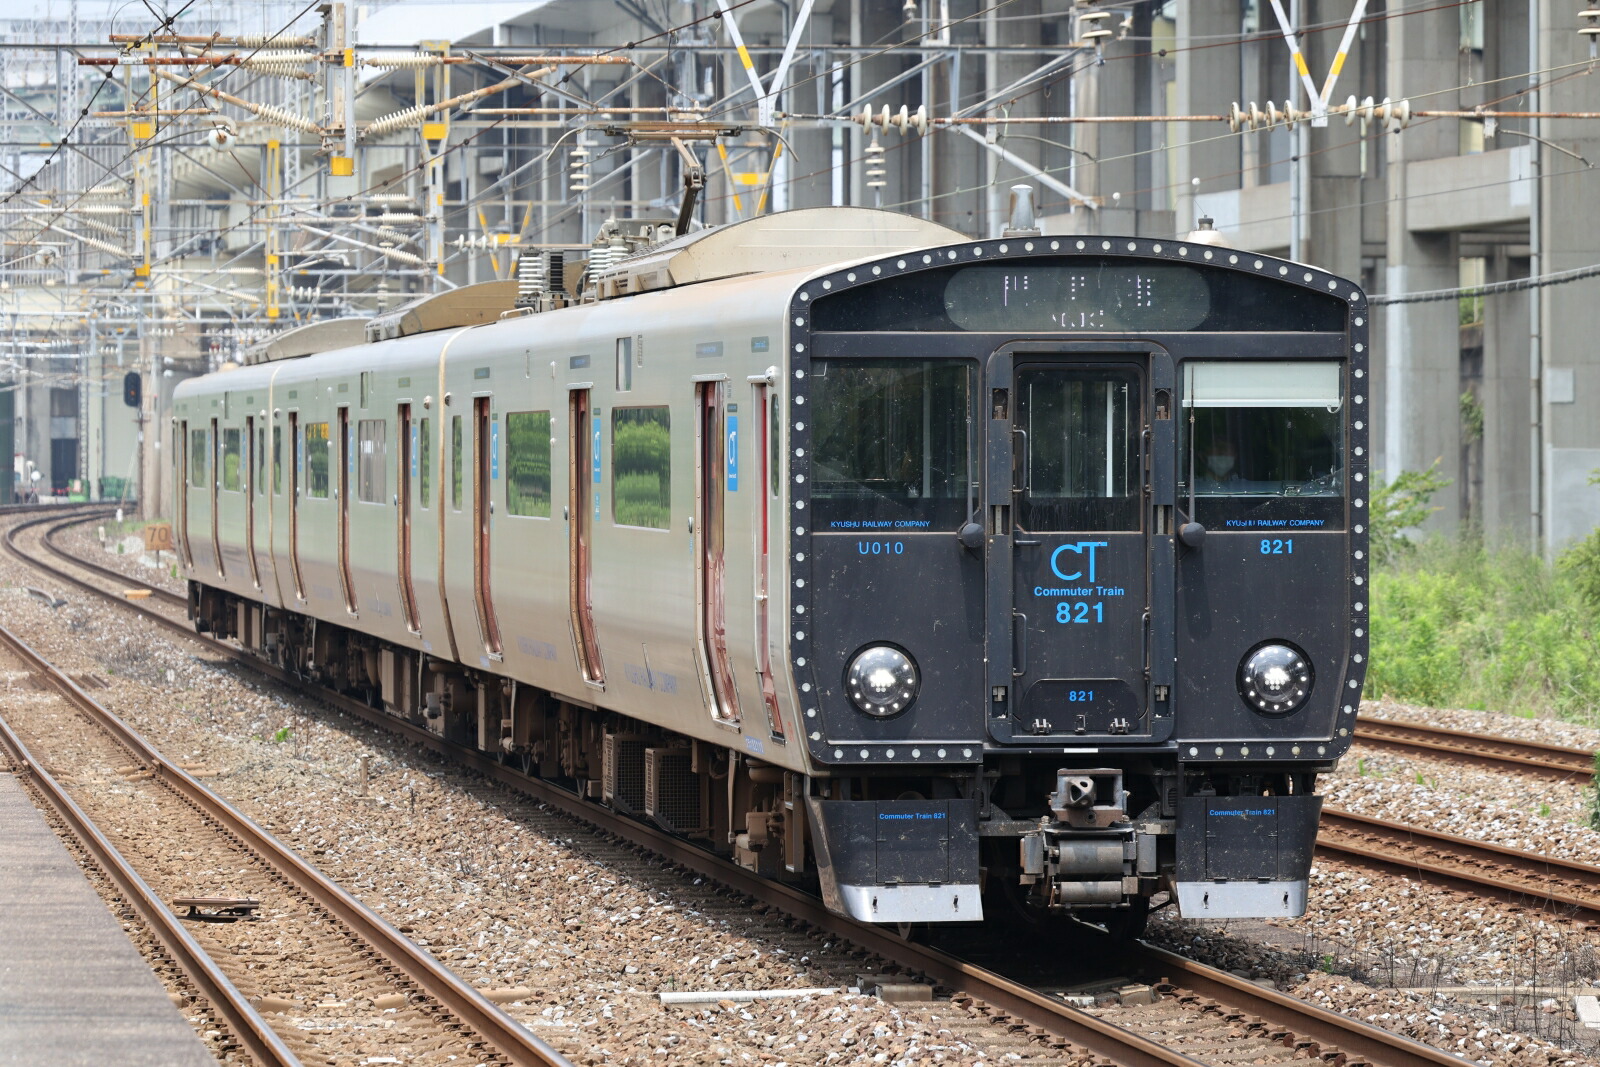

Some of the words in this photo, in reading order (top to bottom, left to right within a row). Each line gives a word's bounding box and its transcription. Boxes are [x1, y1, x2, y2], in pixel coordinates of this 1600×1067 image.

[830, 520, 860, 528] KYUSHU
[862, 520, 893, 528] RAILWAY
[894, 520, 931, 528] COMPANY
[1257, 519, 1288, 527] RAILWAY
[1289, 519, 1325, 527] COMPANY
[147, 526, 168, 543] 70
[858, 541, 904, 555] U010
[1260, 538, 1294, 555] 821
[1050, 541, 1108, 583] CT
[1033, 586, 1093, 597] Commuter
[1095, 586, 1125, 597] Train
[1056, 601, 1104, 624] 821
[1069, 690, 1094, 702] 821
[879, 812, 914, 820] Commuter
[916, 812, 932, 820] Train
[933, 812, 946, 820] 821
